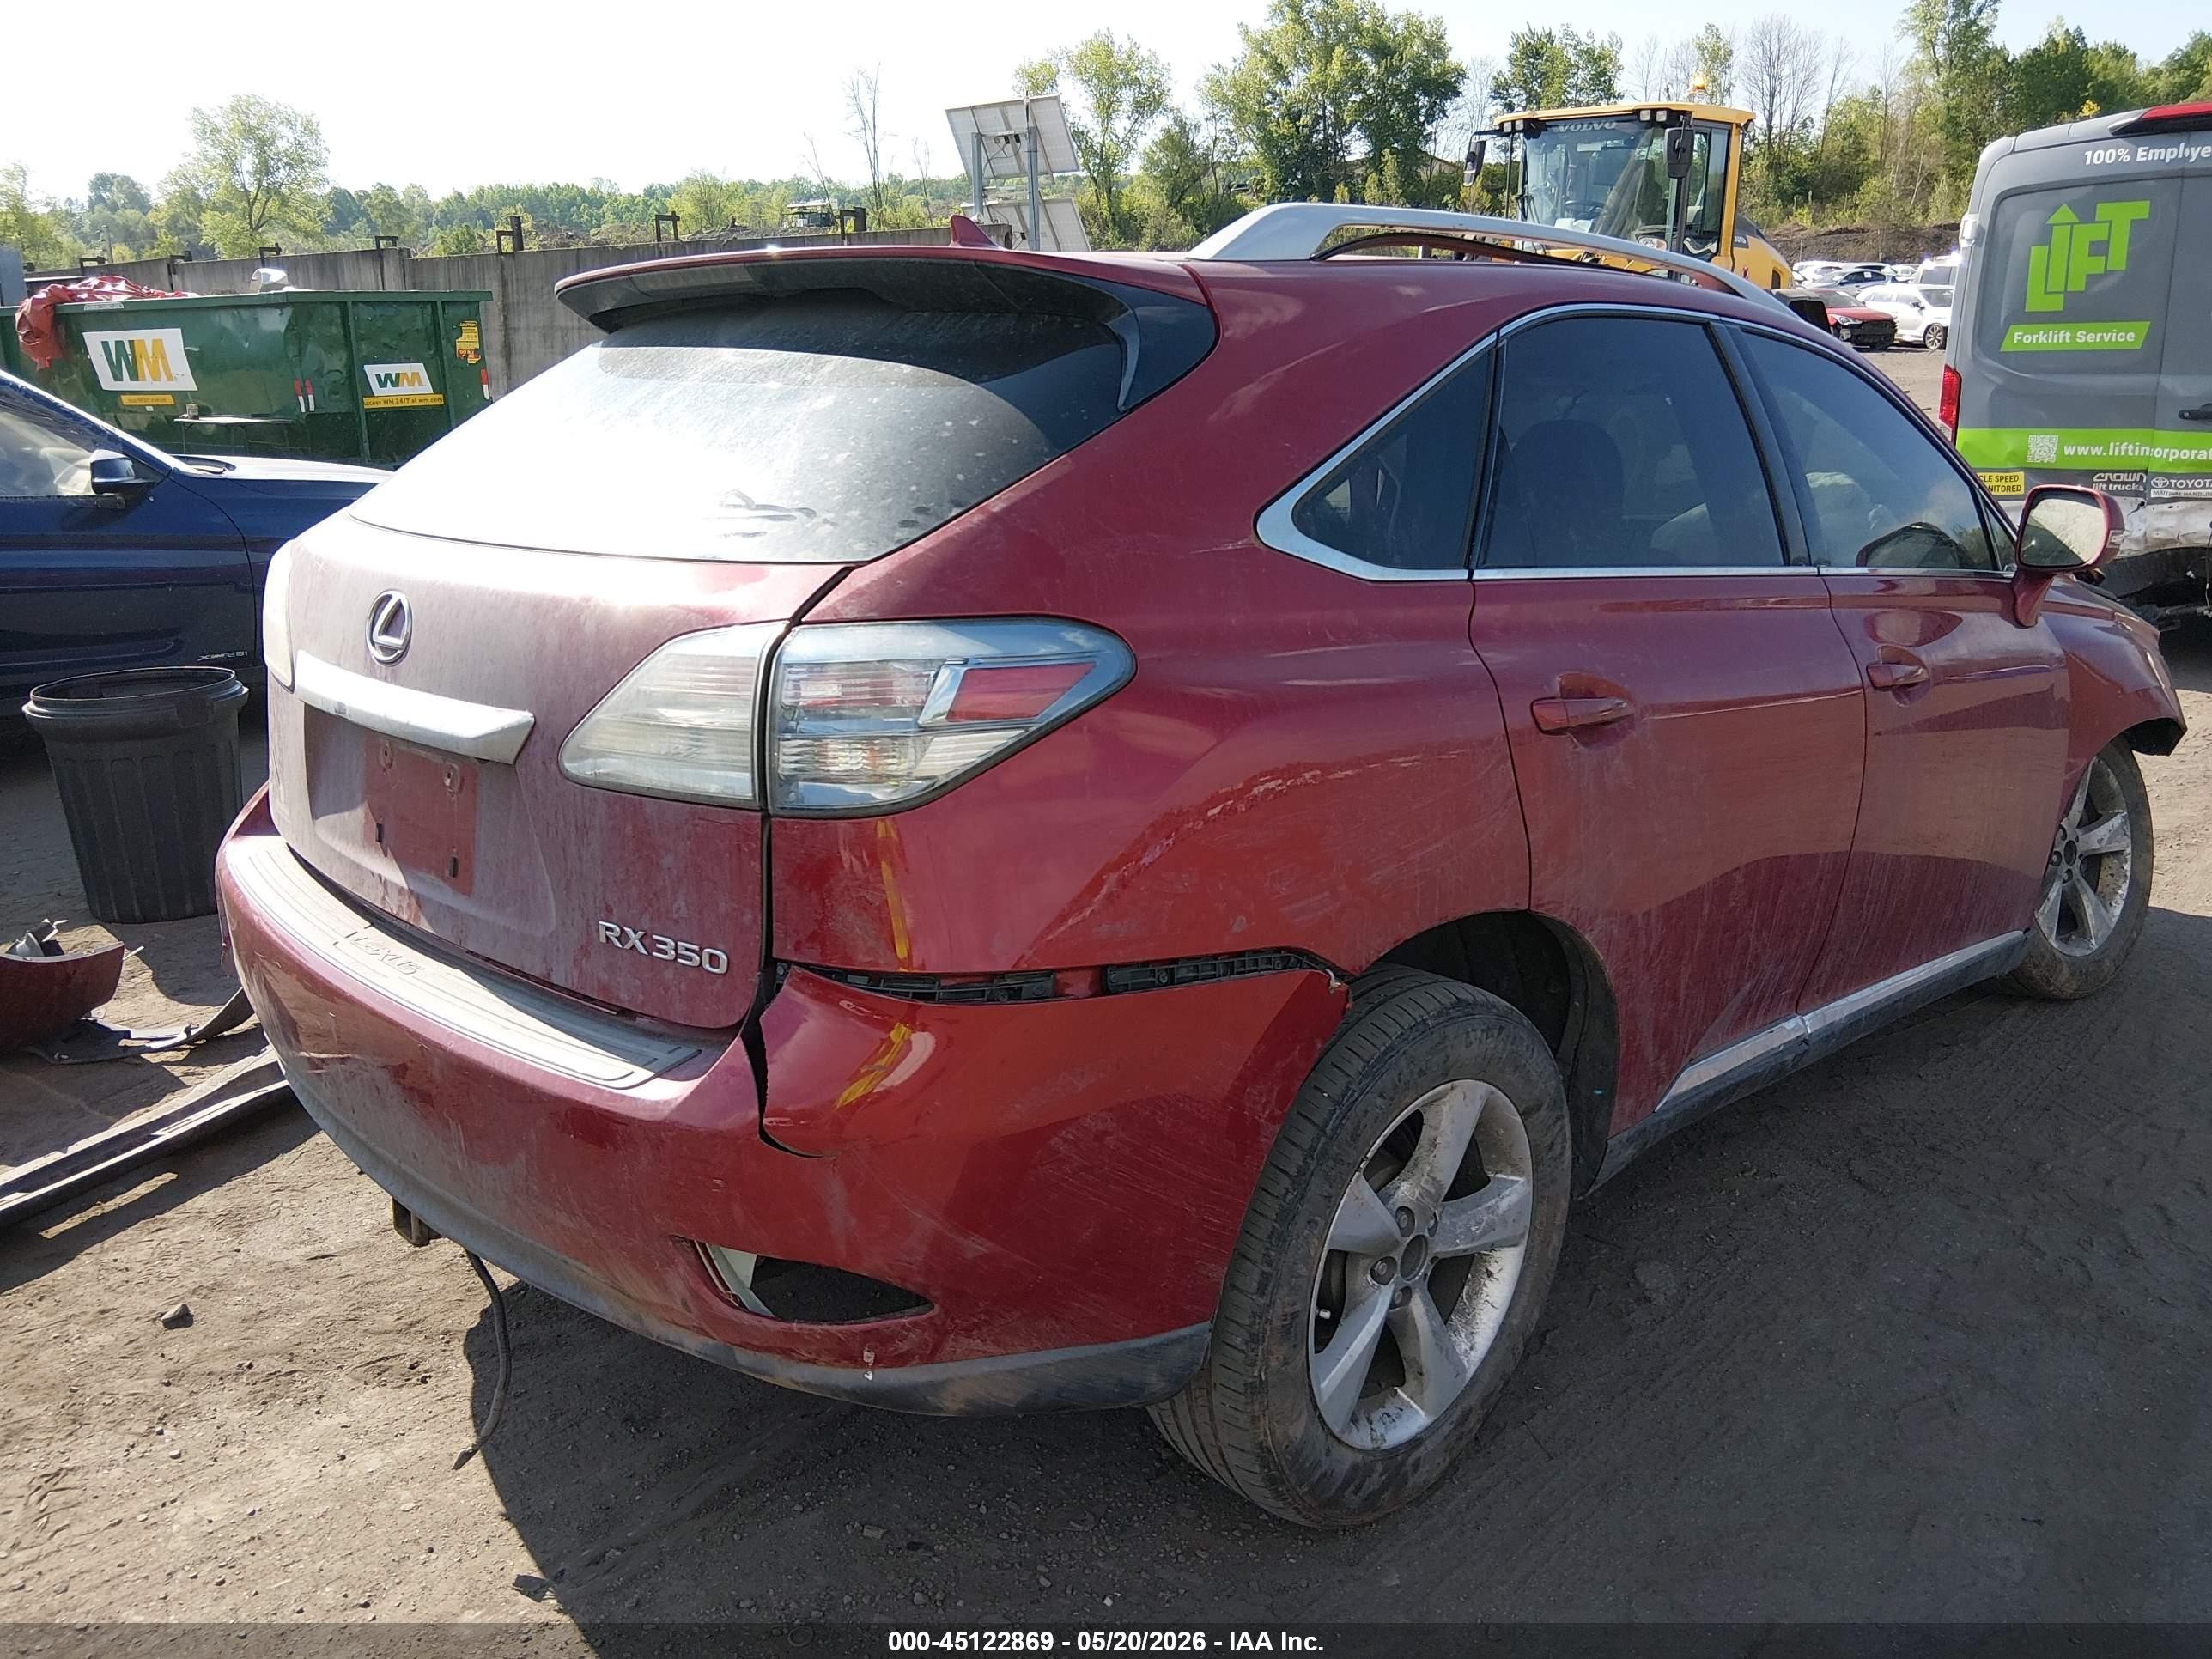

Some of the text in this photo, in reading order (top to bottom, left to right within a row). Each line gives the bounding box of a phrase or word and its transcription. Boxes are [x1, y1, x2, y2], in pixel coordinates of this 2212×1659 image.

[1559, 121, 1616, 132] VOLVO
[2084, 148, 2130, 166] 100%
[2025, 200, 2151, 312] LIFT
[2014, 329, 2136, 343] Forklift Service
[101, 338, 174, 382] WM
[374, 371, 425, 389] WM
[1995, 474, 2020, 483] SPEED
[2093, 472, 2147, 483] CROWN
[2169, 479, 2212, 489] TOYOT
